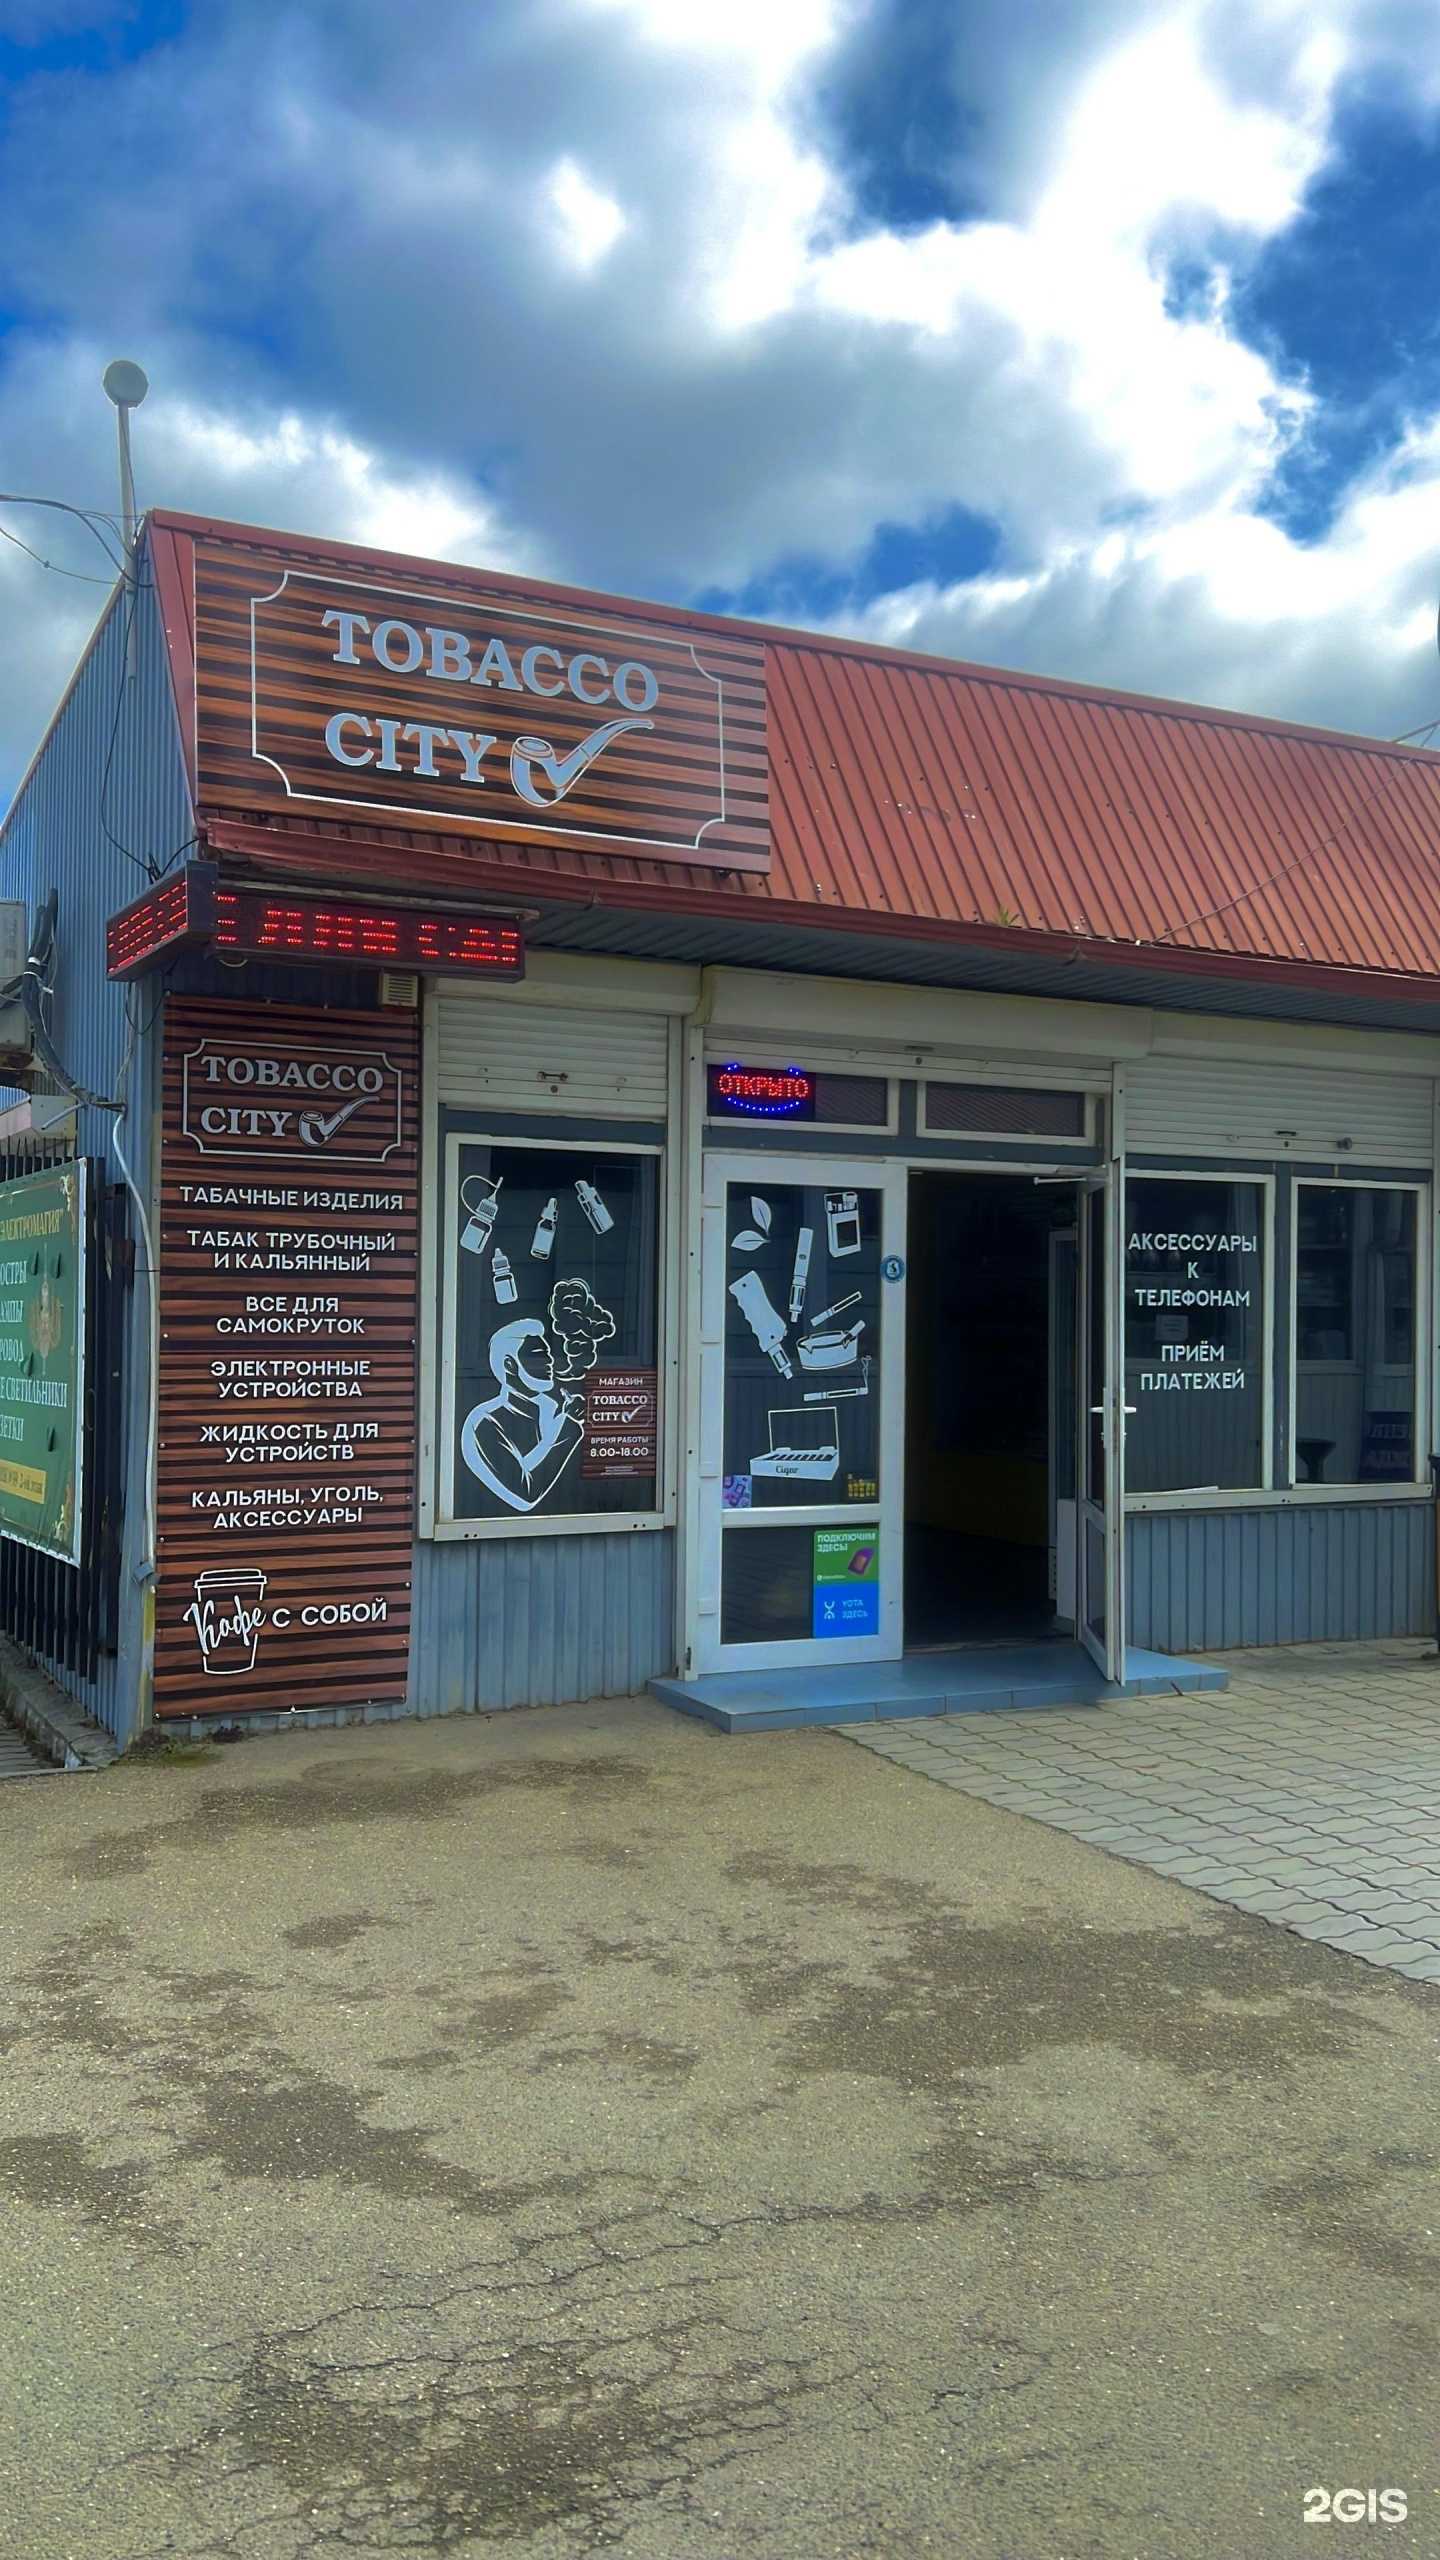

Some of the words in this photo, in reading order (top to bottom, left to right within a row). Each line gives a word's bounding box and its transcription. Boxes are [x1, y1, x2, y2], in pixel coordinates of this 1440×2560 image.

[321, 609, 659, 712] TOBACCO
[325, 712, 497, 783] CITY
[201, 1055, 384, 1093] TOBACCO
[719, 1073, 809, 1098] ОТКРЫТО
[201, 1106, 293, 1137] CITY
[179, 1185, 298, 1206] ТАБАЧНЫЕ
[303, 1191, 403, 1211] ИЗДЕЛИЯ
[186, 1230, 259, 1247] ТАБАК
[266, 1231, 395, 1251] ТРУБОЧНЫЙ
[1128, 1233, 1256, 1252] АКСЕССУАРЫ
[214, 1252, 230, 1269] И
[236, 1252, 370, 1271] КАЛЬЯННЫЙ
[1187, 1261, 1200, 1279] К
[246, 1296, 287, 1312] ВСЕ
[292, 1297, 339, 1314] ДЛЯ
[1134, 1289, 1250, 1307] ТЕЛЕФОНАМ
[216, 1317, 365, 1334] САМОКРУТОК
[1161, 1340, 1225, 1362] ПРИЁМ
[210, 1360, 371, 1377] ЭЛЕКТРОННЫЕ
[219, 1378, 362, 1398] УСТРОЙСТВА
[599, 1377, 643, 1386] МАГАЗИН
[1140, 1368, 1245, 1390] ПЛАТЕЖЕЙ
[6, 1377, 68, 1408] СВЕТИЛЬНИКИ
[592, 1395, 648, 1405] TOBACCO
[592, 1411, 620, 1421] CITY
[200, 1424, 328, 1443] ЖИДКОСТЬ
[333, 1423, 379, 1441] ДЛЯ
[617, 1436, 648, 1444] РАБОТЫ
[225, 1441, 354, 1463] УСТРОЙСТВ
[590, 1447, 648, 1457] 8.00-18.00
[775, 1465, 800, 1476] Cigar
[191, 1489, 305, 1508] КАЛЬЯНЫ,
[310, 1486, 384, 1503] УГОЛЬ,
[213, 1507, 362, 1529] АКСЕССУАРЫ
[817, 1532, 876, 1544] ПОДКЛЮЧИМ
[842, 1599, 864, 1608] YOTA
[842, 1609, 869, 1620] ЗДЕСЬ
[183, 1595, 267, 1655] Кофе
[272, 1608, 291, 1628] С
[301, 1597, 387, 1626] СОБОЙ
